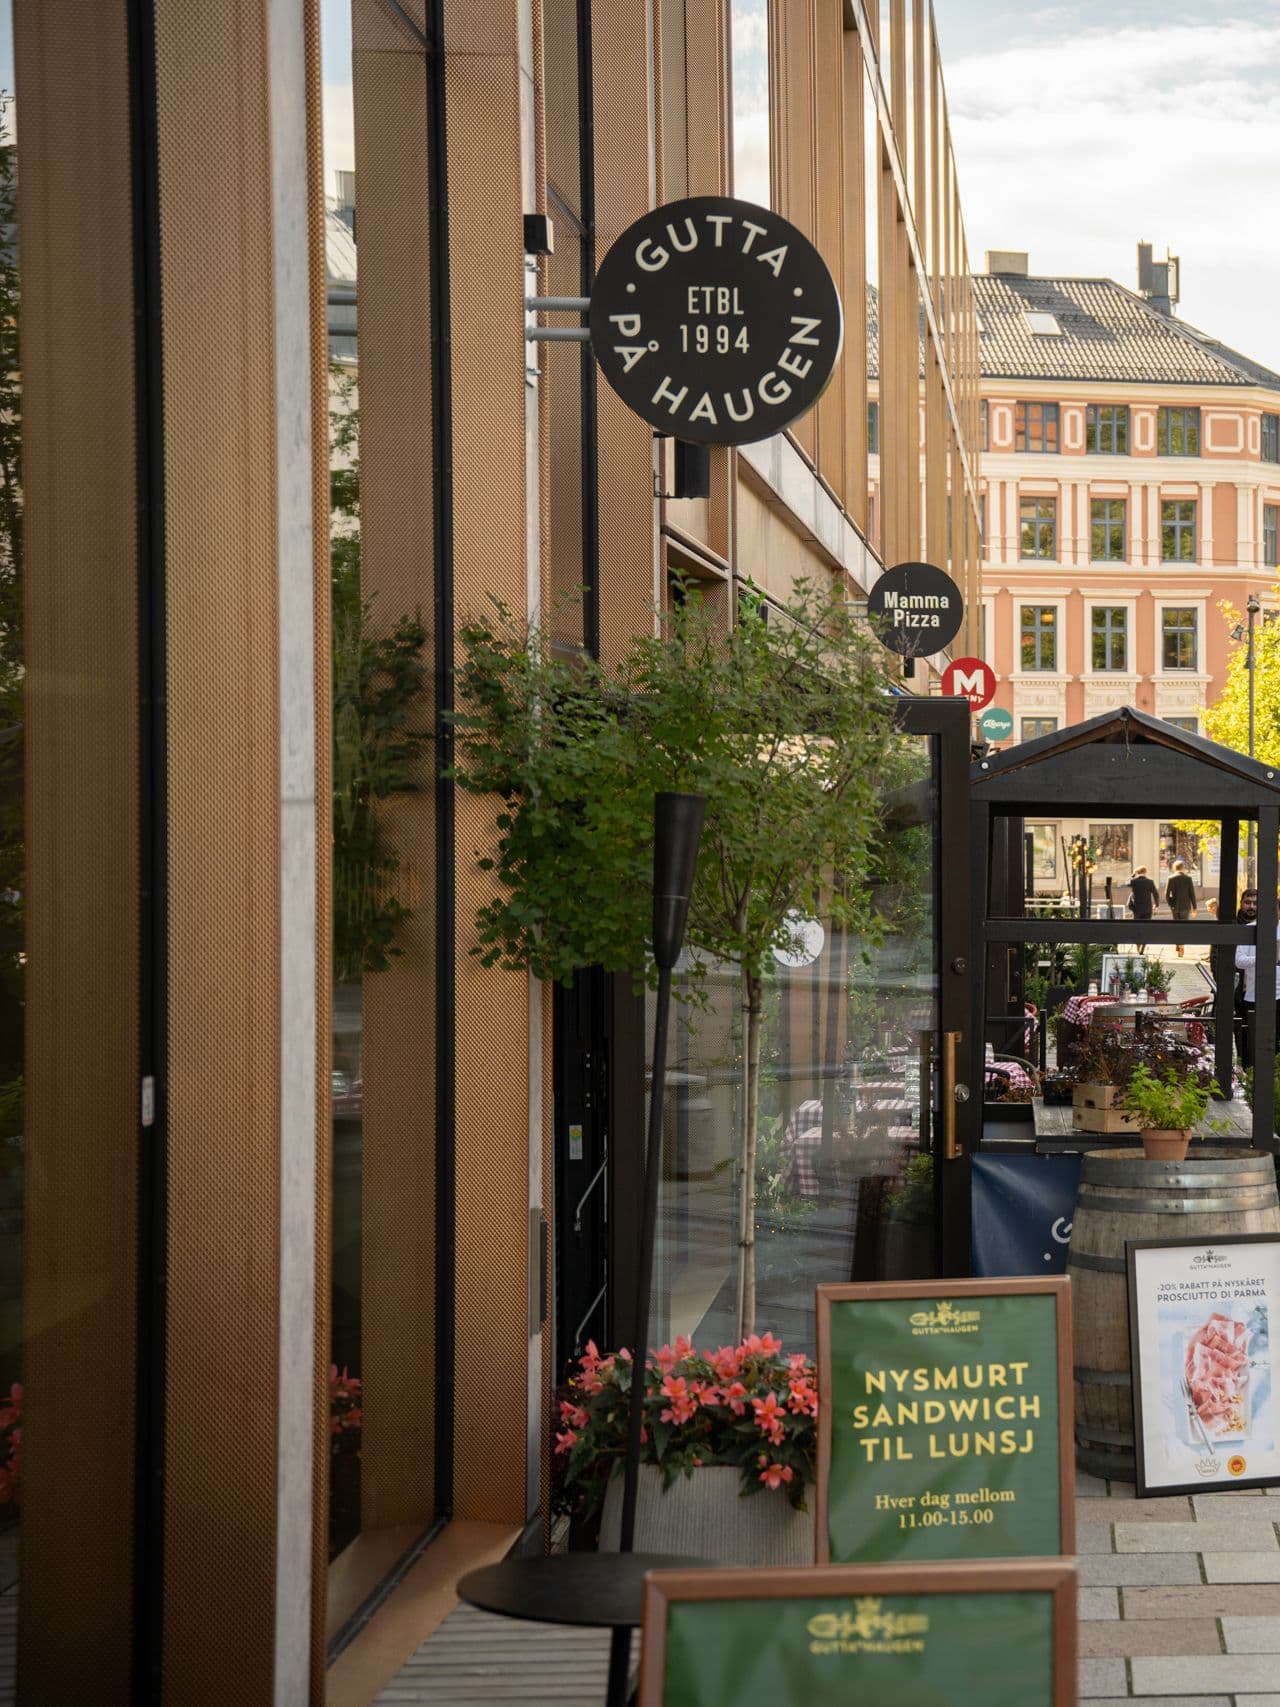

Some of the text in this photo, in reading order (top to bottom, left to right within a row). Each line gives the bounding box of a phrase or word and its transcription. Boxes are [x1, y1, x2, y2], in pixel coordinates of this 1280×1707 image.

[635, 215, 788, 278] GUTTA
[687, 286, 744, 314] ETBL
[679, 324, 750, 354] 1994
[609, 314, 822, 425] PÅ HAUGEN
[884, 591, 949, 609] Mamma
[893, 609, 940, 628] Pizza
[953, 669, 985, 696] M
[1157, 1288, 1266, 1302] PROSCIUTTO DI PARMA
[1179, 1281, 1209, 1290] RABATT
[1212, 1279, 1222, 1288] PÅ
[1224, 1277, 1265, 1288] NYSKÅRET
[865, 1362, 1029, 1394] NYSMURT
[853, 1395, 1040, 1429] SANDWICH
[859, 1429, 1034, 1462] TIL LUNSJ
[875, 1487, 1016, 1510] Hver dag mellom
[899, 1508, 994, 1529] 11.00-15.00
